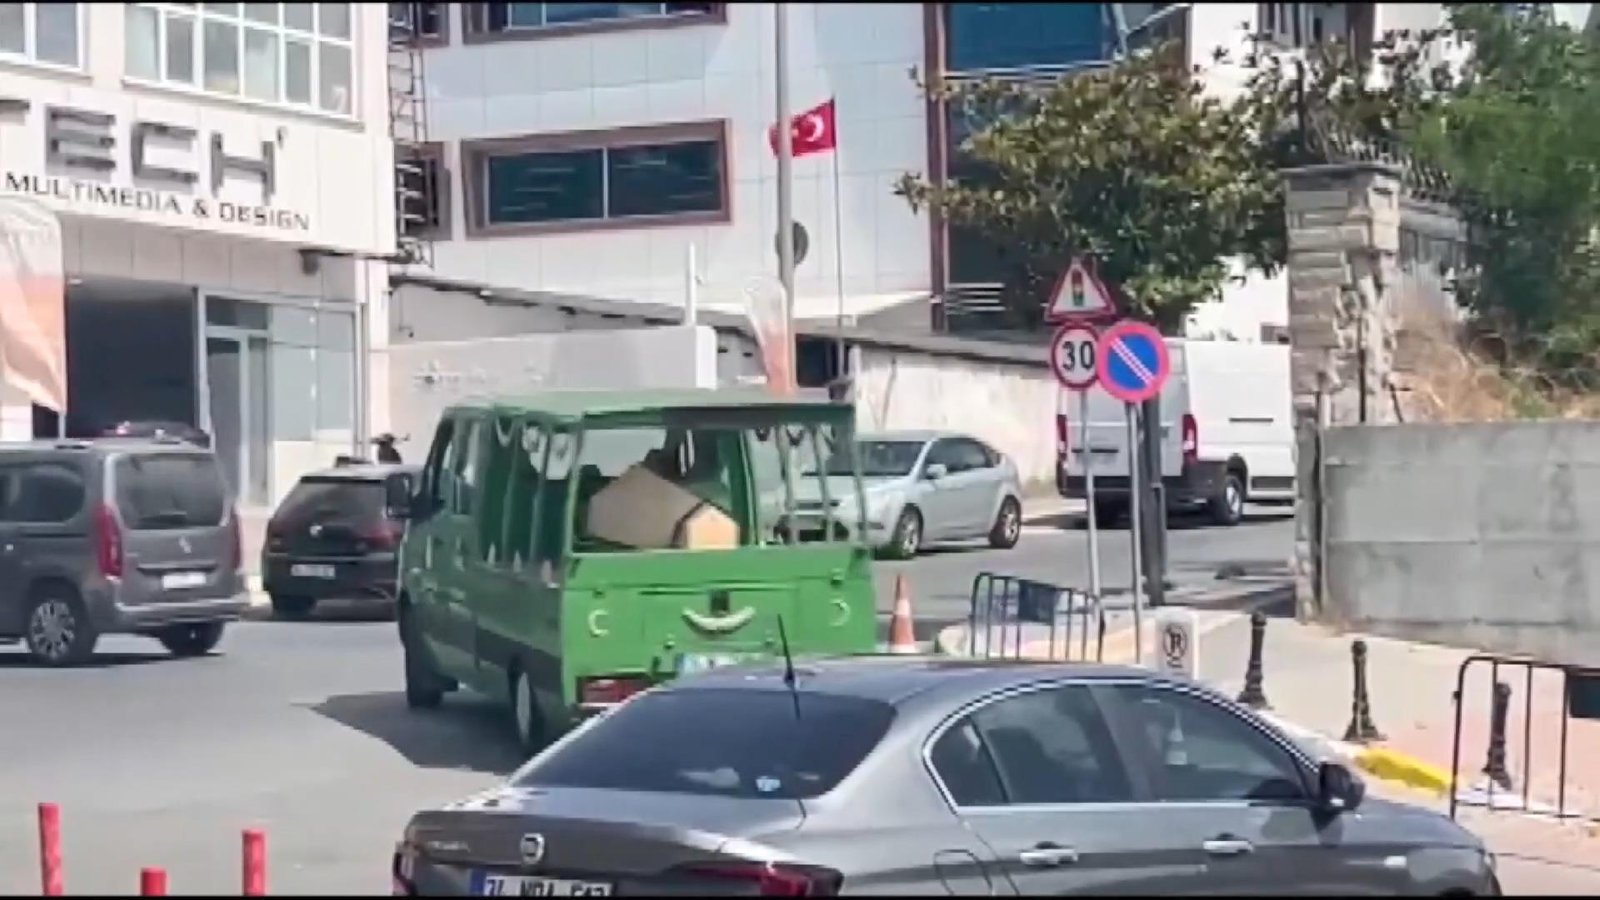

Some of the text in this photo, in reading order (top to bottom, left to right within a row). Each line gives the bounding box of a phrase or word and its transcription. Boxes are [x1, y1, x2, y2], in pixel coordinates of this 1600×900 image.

[0, 98, 276, 206] ECH
[5, 171, 311, 231] MULTIMEDIA & DESIGN
[1063, 341, 1095, 370] 30
